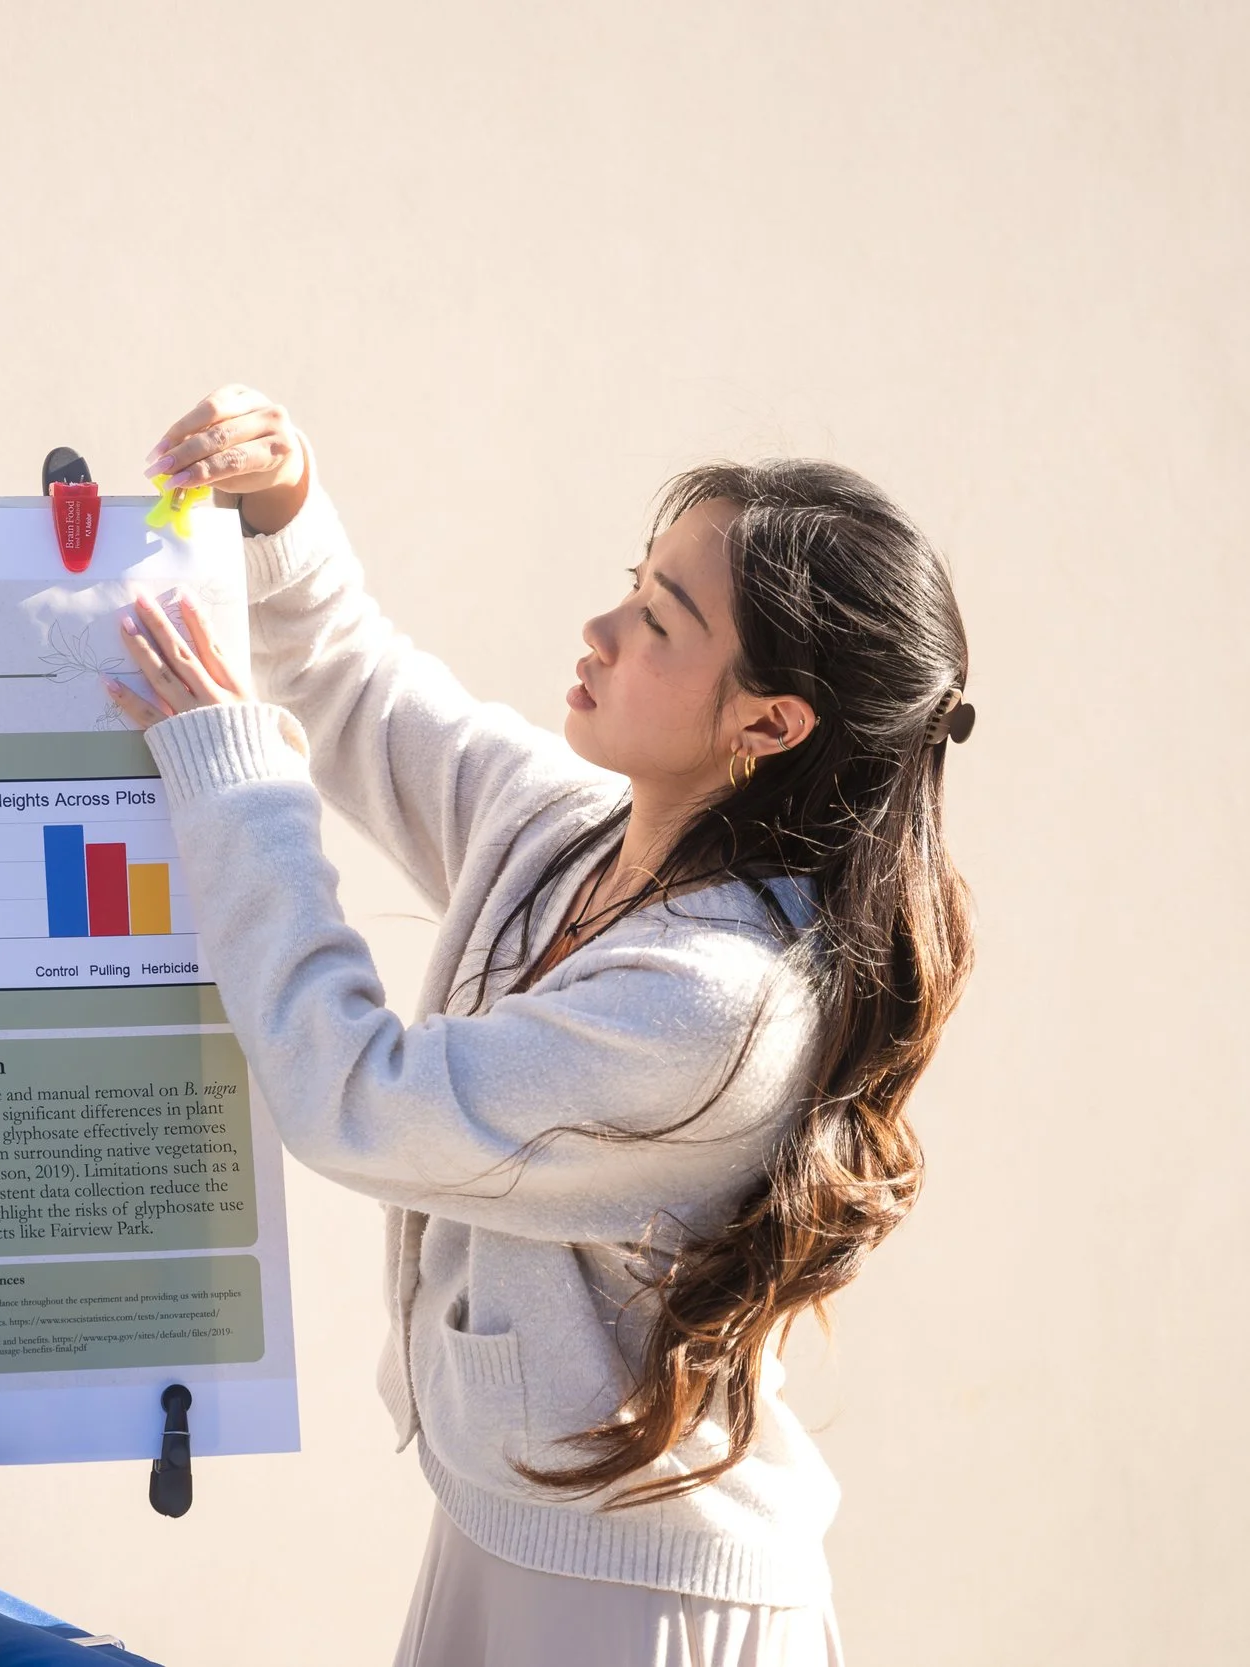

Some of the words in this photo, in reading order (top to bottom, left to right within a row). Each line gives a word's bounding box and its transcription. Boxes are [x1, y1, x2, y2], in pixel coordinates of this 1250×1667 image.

[66, 500, 75, 524] Food
[66, 525, 74, 549] Brain
[55, 791, 110, 806] Across
[115, 790, 156, 805] Plots
[35, 965, 79, 977] Control
[89, 964, 131, 978] Pulling
[141, 962, 200, 975] Herbicide
[2, 1124, 80, 1145] glyphosate
[83, 1122, 159, 1143] effectively
[163, 1124, 227, 1135] removes
[19, 1224, 46, 1238] like
[50, 1221, 113, 1237] Fairview
[116, 1220, 154, 1236] Park.
